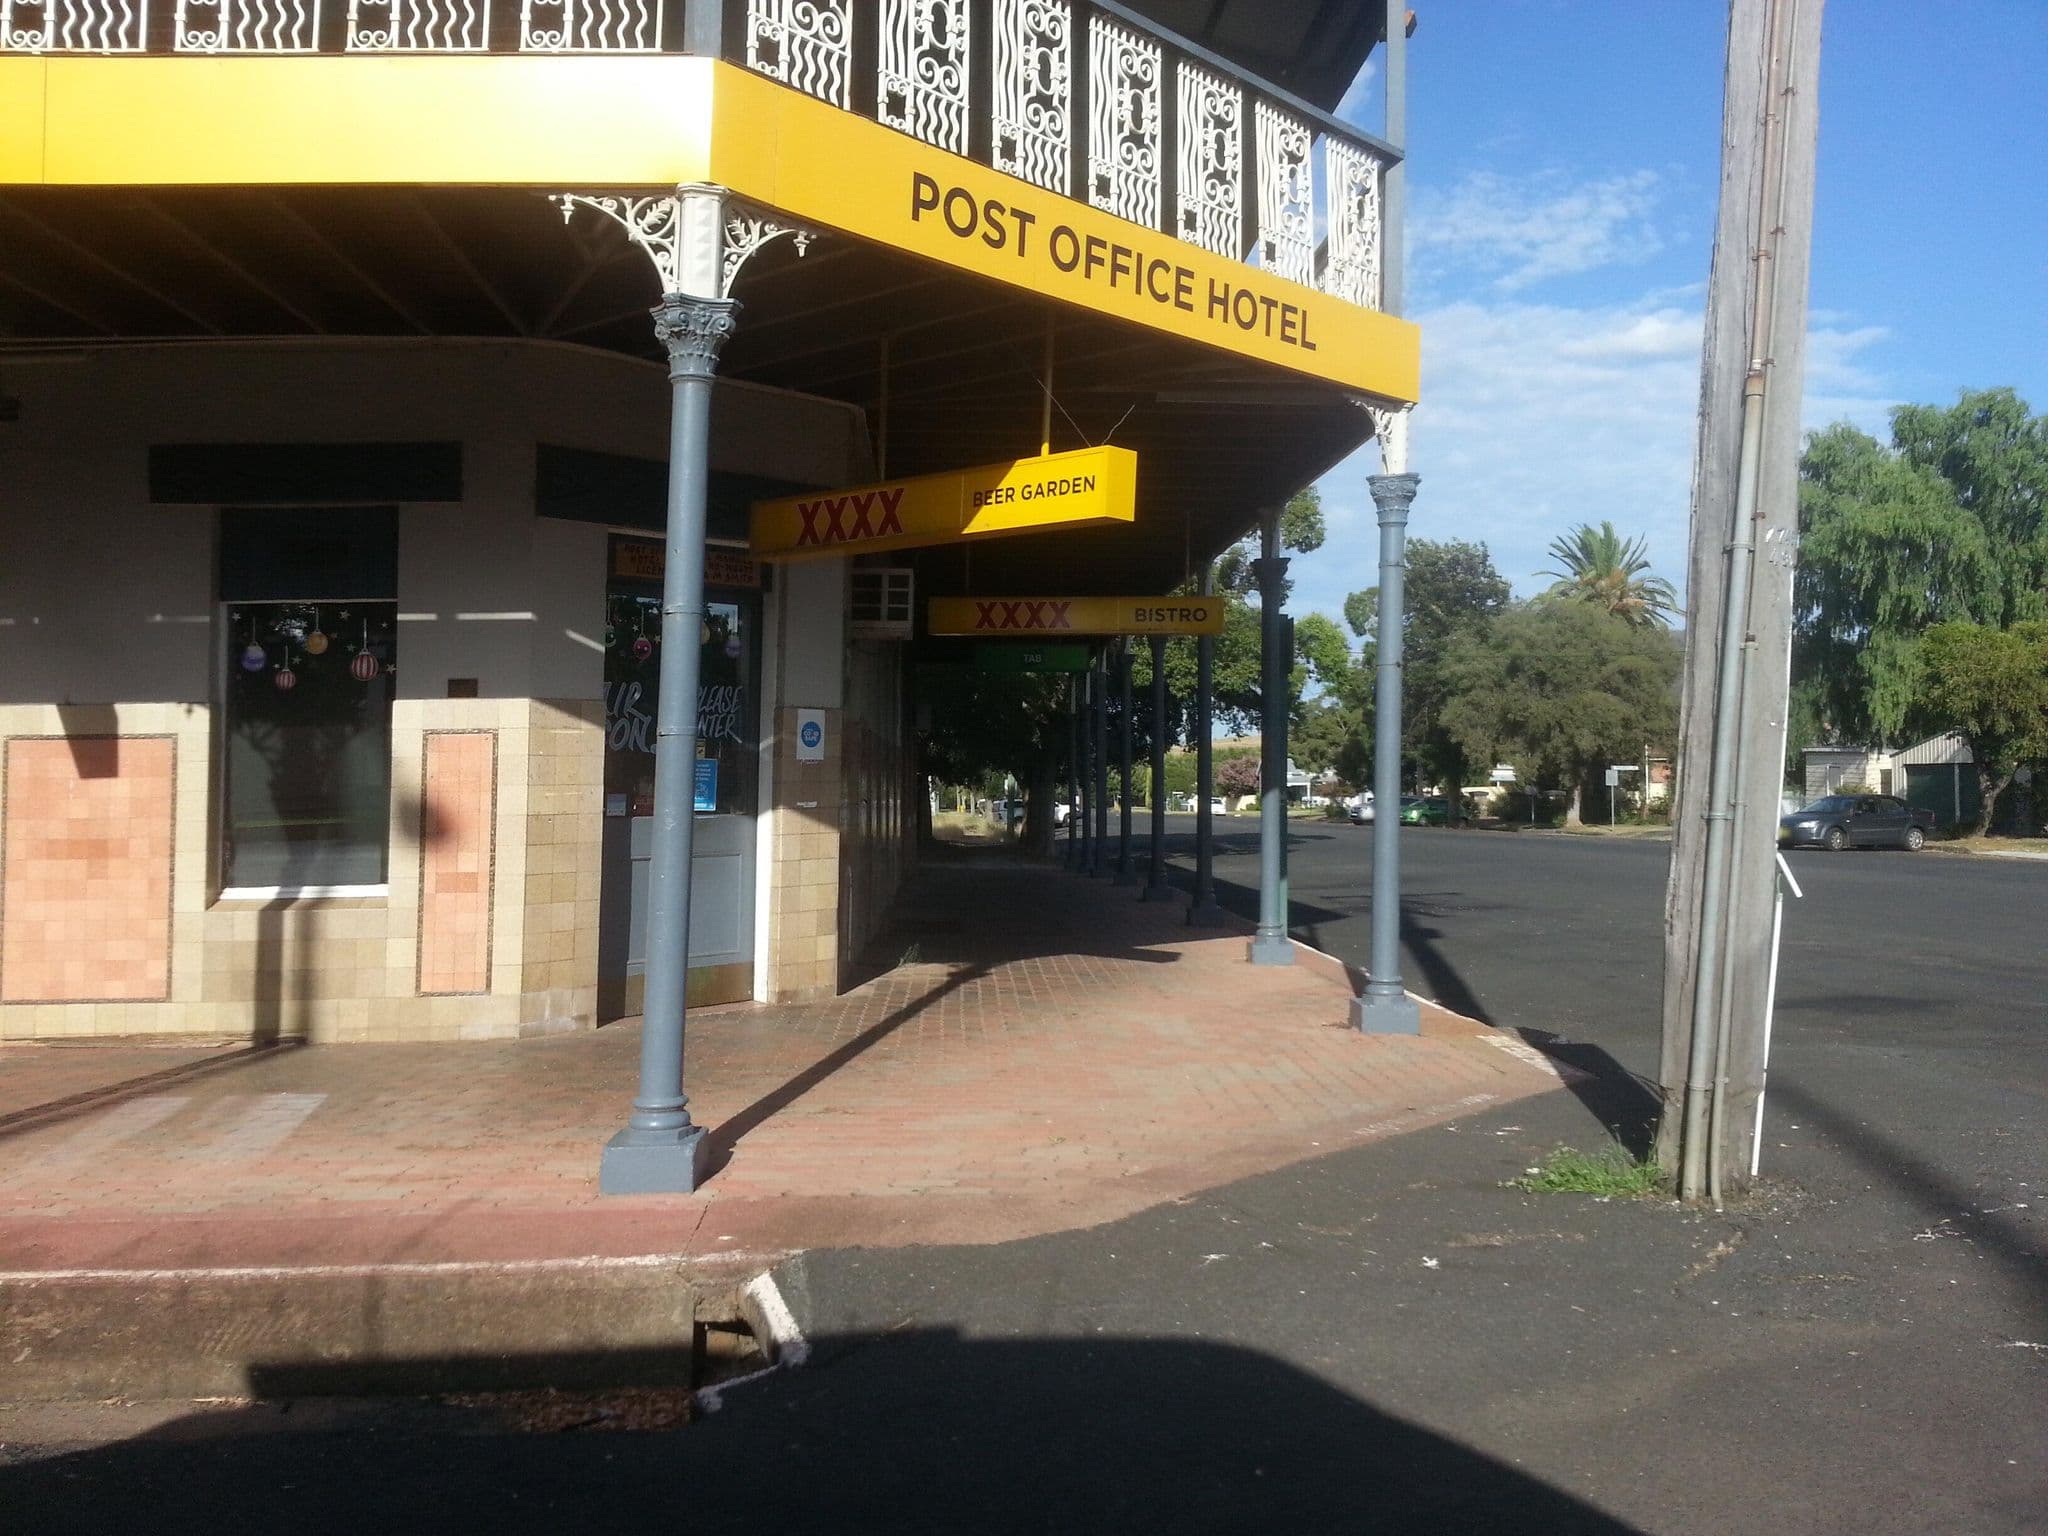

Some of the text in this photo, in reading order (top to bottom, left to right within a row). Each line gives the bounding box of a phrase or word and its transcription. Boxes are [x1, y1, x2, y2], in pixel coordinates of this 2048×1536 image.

[912, 171, 1316, 351] POST OFFICE HOTEL
[973, 475, 1096, 508] BEER GARDEN
[797, 488, 904, 546] XXXX
[975, 601, 1072, 630] XXXX
[1135, 608, 1208, 623] BISTRO
[1023, 653, 1042, 665] TAB
[698, 714, 743, 744] NTER
